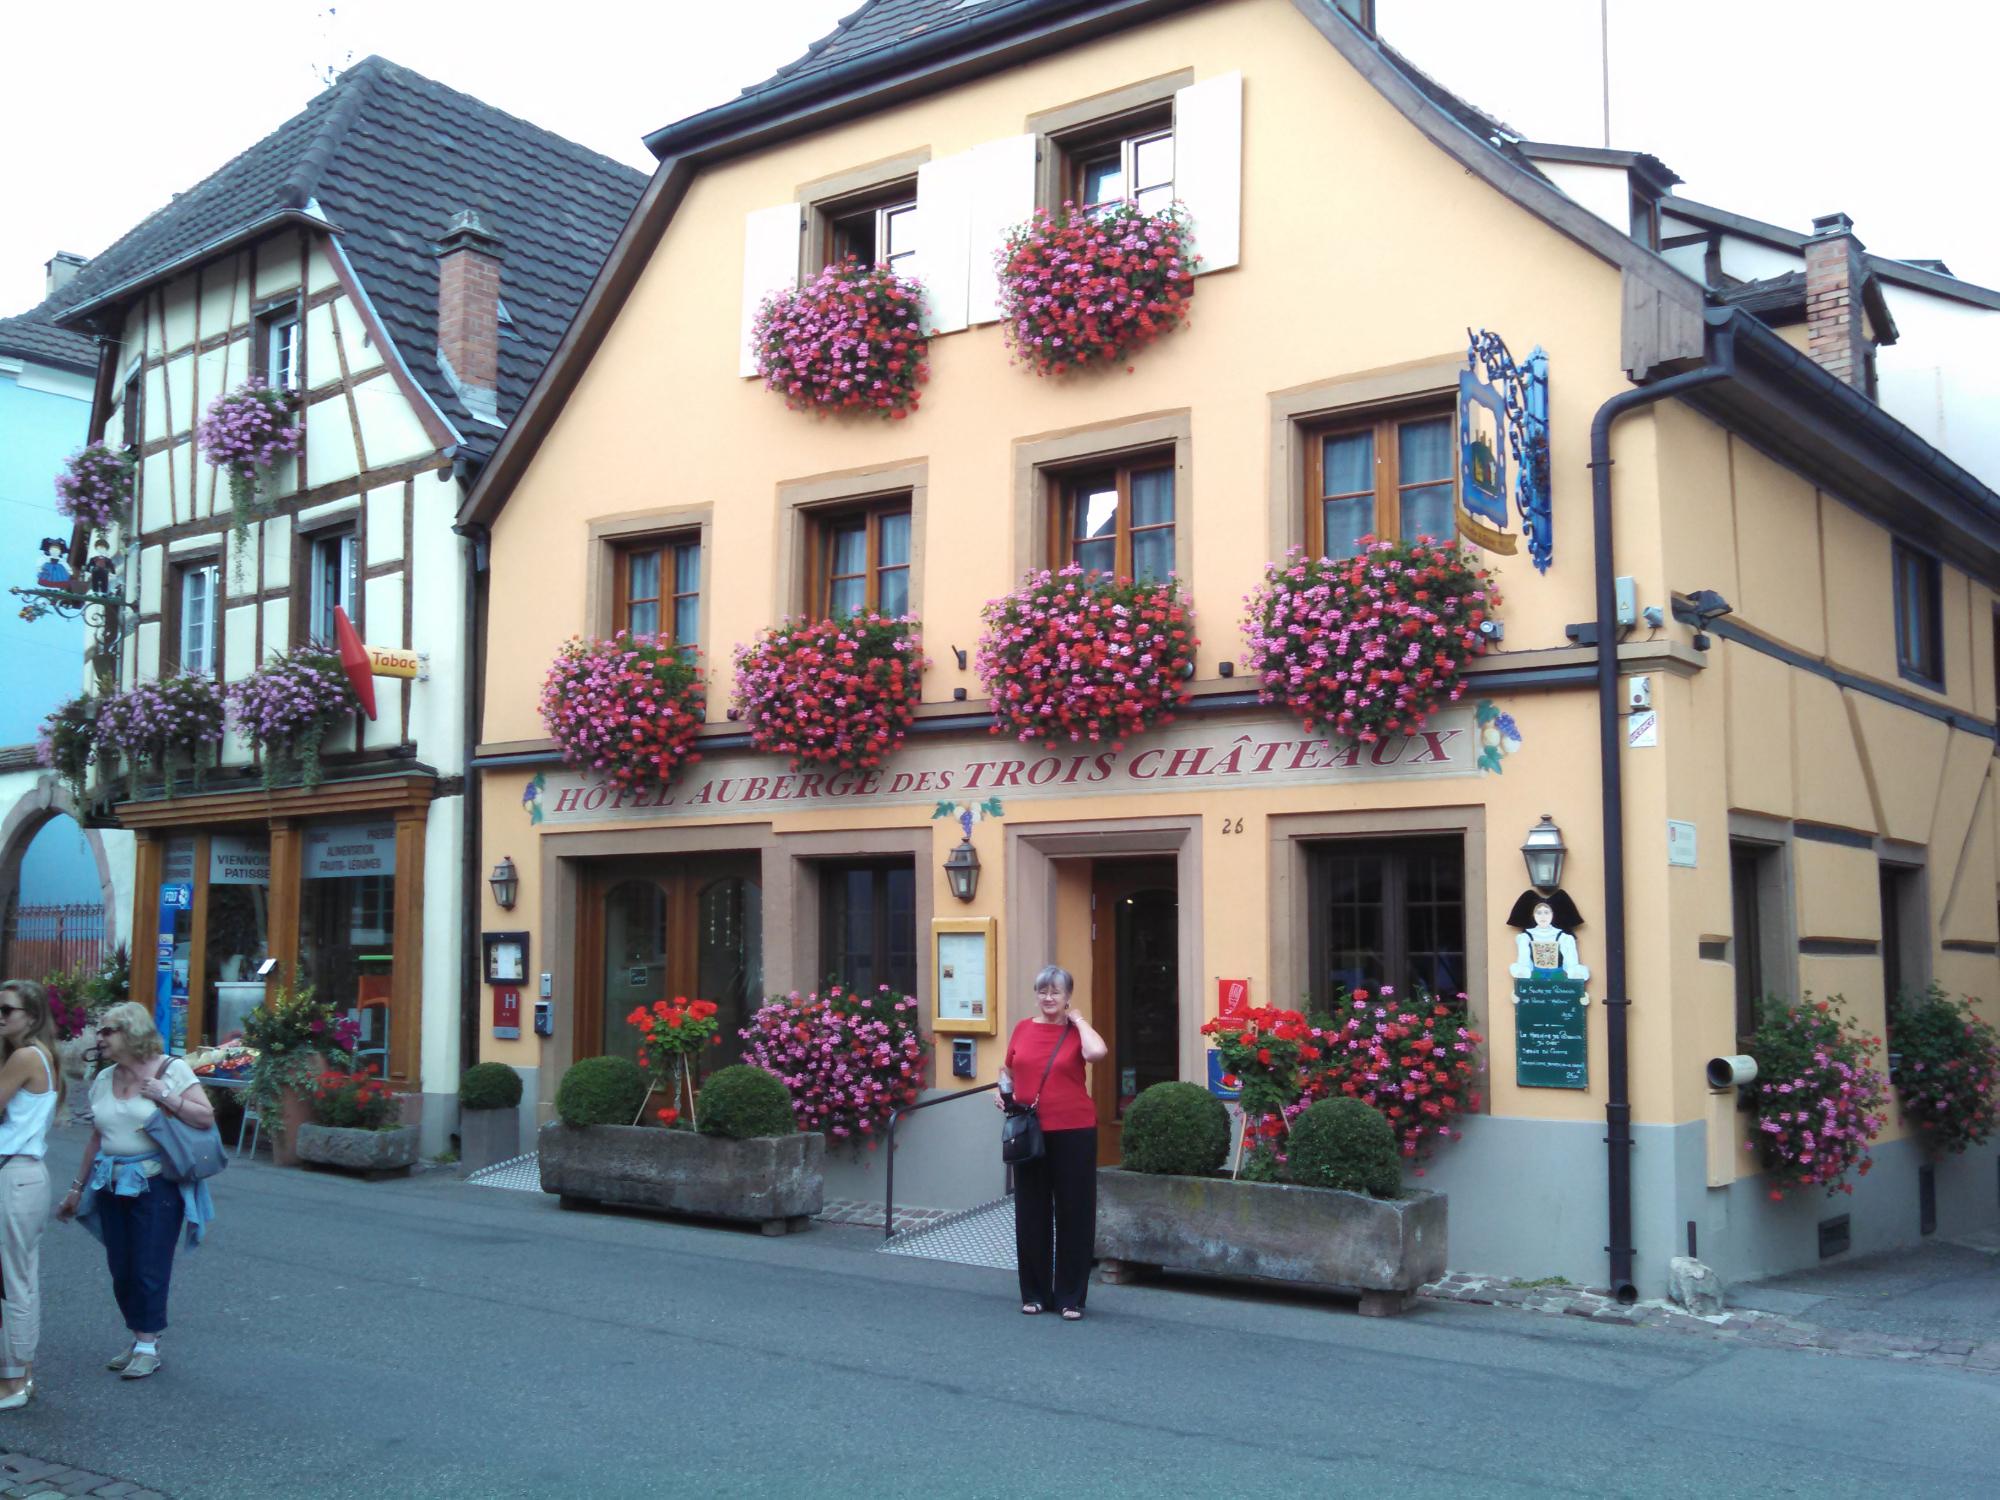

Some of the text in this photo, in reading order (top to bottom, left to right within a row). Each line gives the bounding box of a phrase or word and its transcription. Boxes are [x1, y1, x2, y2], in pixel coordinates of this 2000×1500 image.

[371, 651, 418, 670] Tabac
[686, 767, 886, 804] AUBERGE
[889, 770, 955, 793] DES
[961, 752, 1117, 789] TROIS
[1128, 729, 1464, 779] CHÂTEAUX
[1221, 816, 1245, 835] 26
[504, 992, 517, 1009] H
